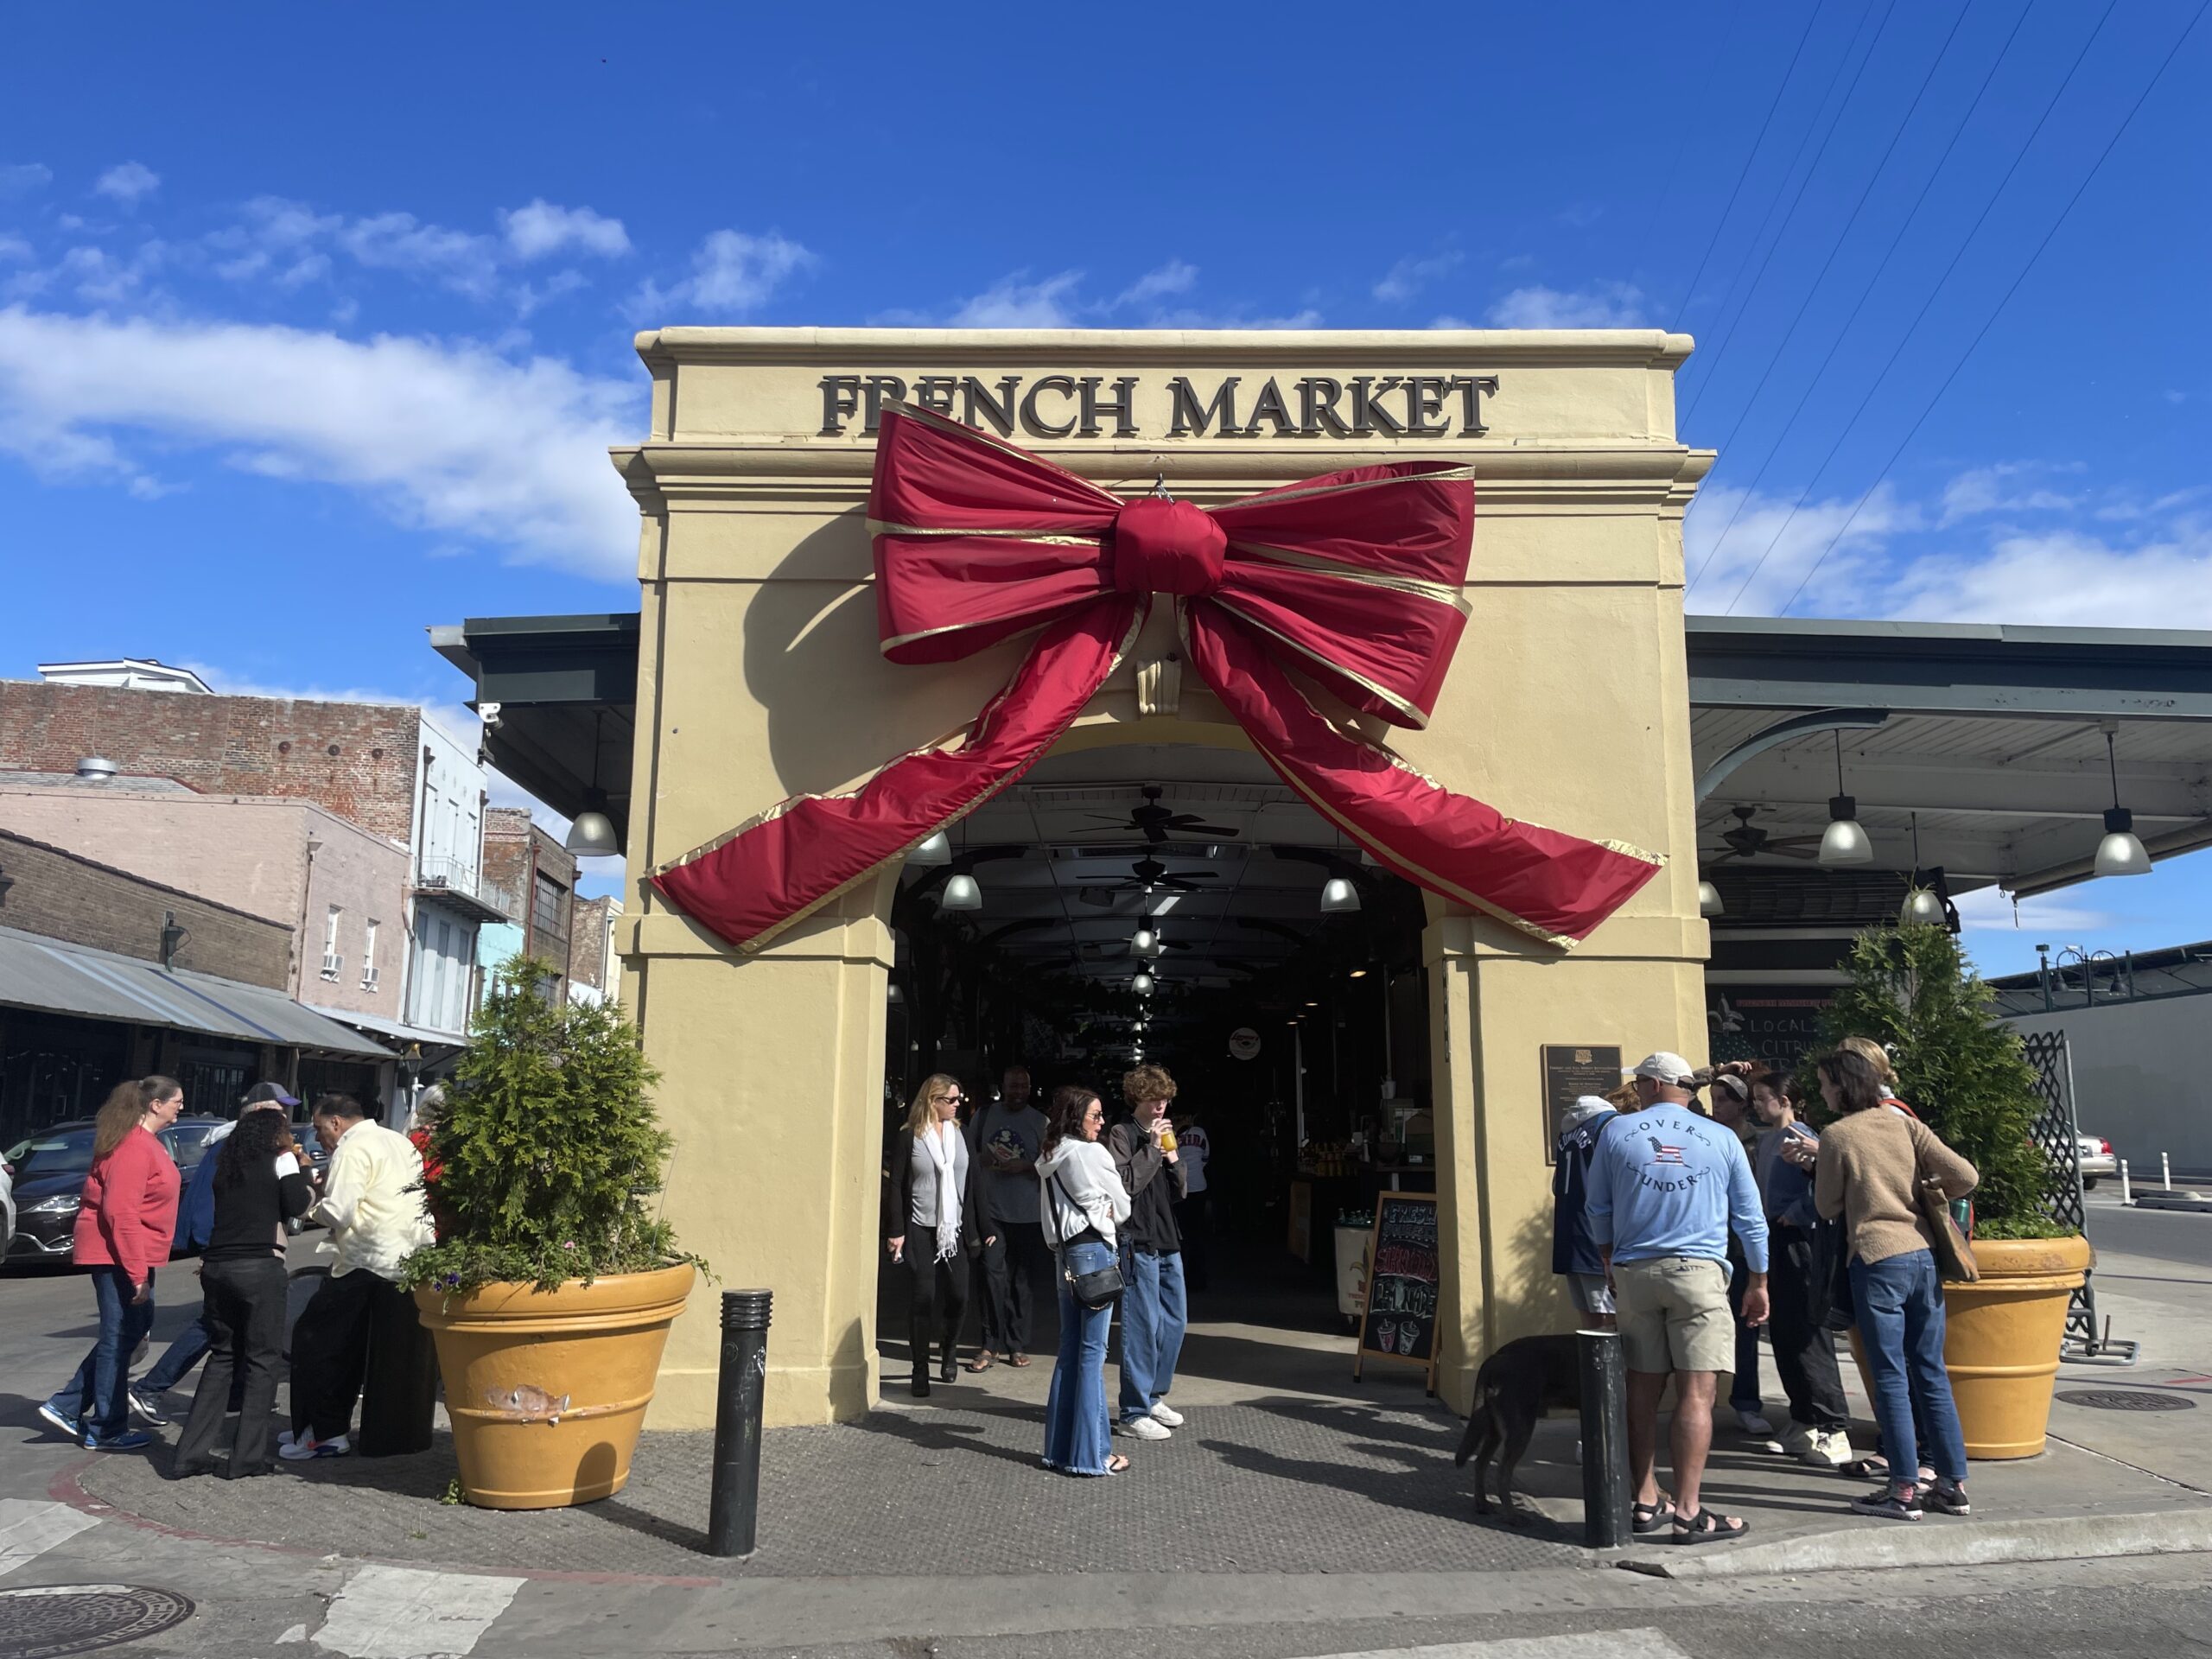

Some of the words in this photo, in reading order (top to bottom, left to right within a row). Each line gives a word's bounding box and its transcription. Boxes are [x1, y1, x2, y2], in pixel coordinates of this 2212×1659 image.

[1171, 375, 1500, 432] MARKET
[1750, 1018, 1812, 1033] LOCAL
[1762, 1039, 1812, 1056] CITRU
[1638, 1119, 1696, 1135] OVER
[1641, 1174, 1698, 1192] UNDER
[1389, 1205, 1437, 1225] FRESH
